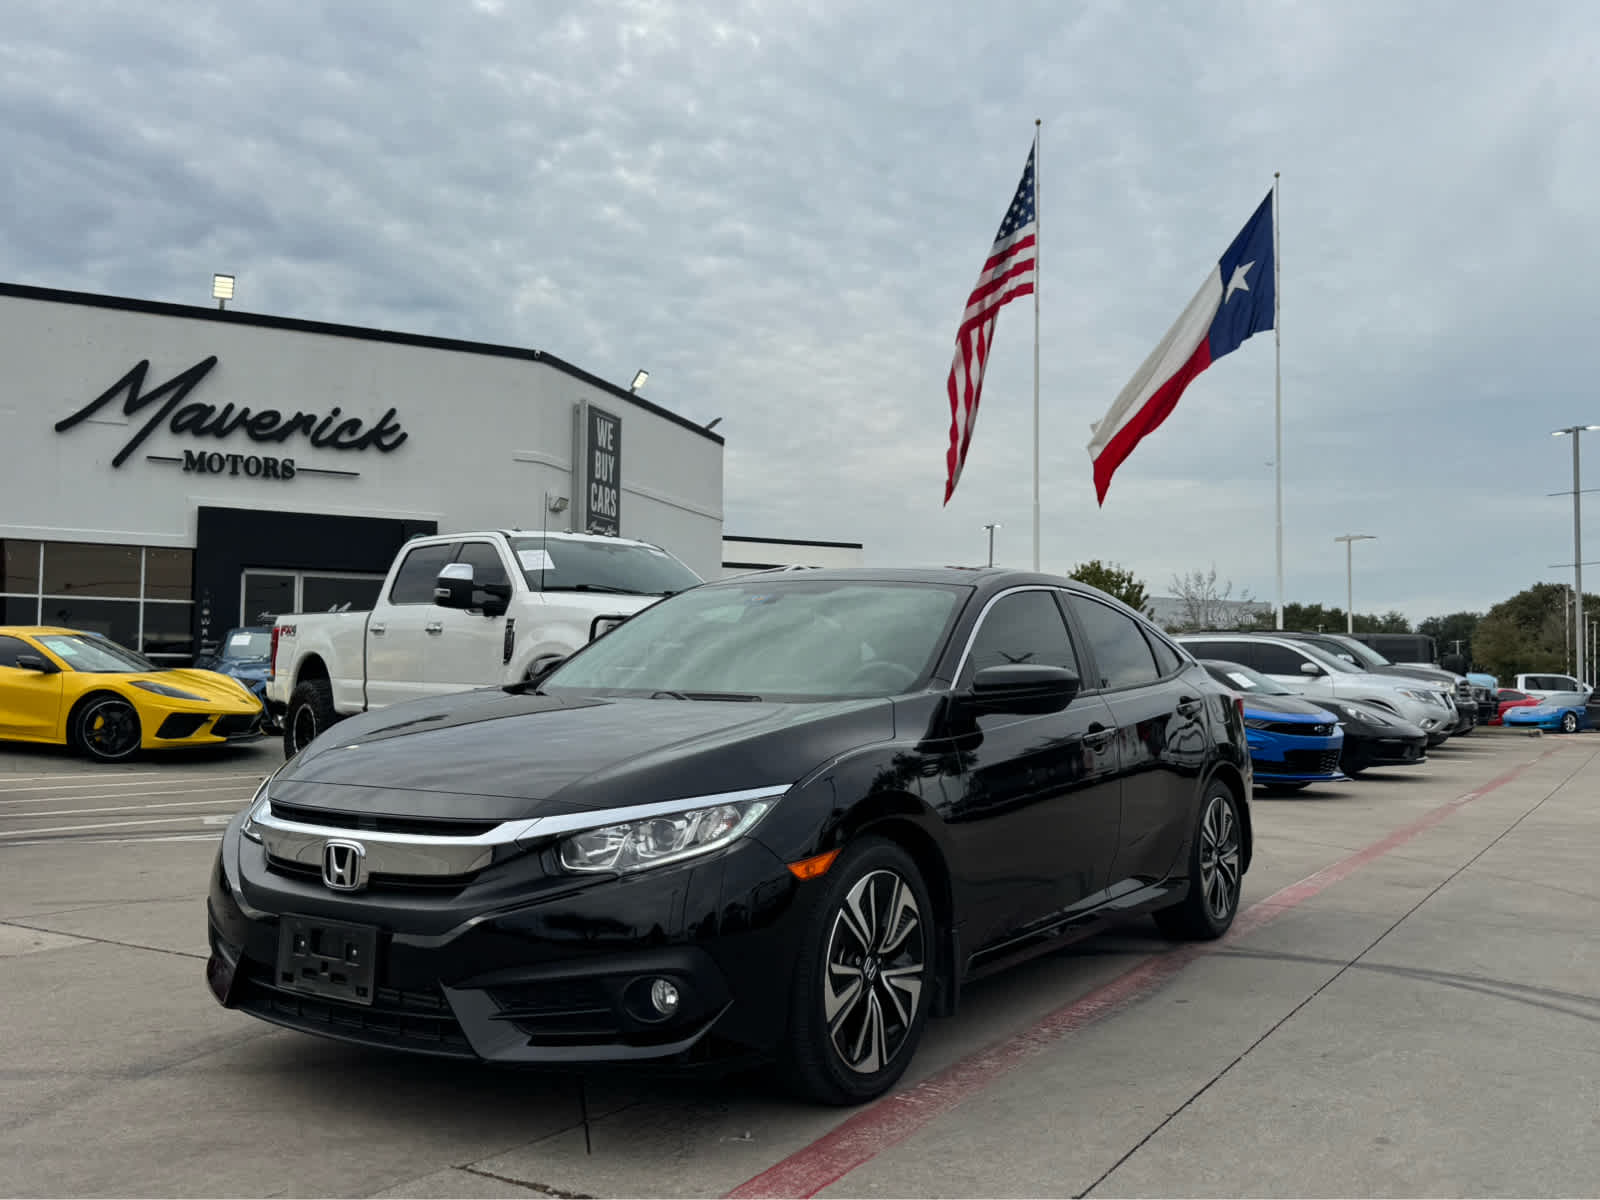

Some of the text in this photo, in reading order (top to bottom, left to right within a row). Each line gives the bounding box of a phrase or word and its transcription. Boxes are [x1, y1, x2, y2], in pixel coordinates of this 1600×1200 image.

[55, 355, 408, 468] Maverick
[596, 417, 614, 451] WE
[183, 449, 296, 480] MOTORS
[594, 449, 615, 484] BUY
[590, 482, 617, 517] CARS
[280, 624, 297, 637] FX4
